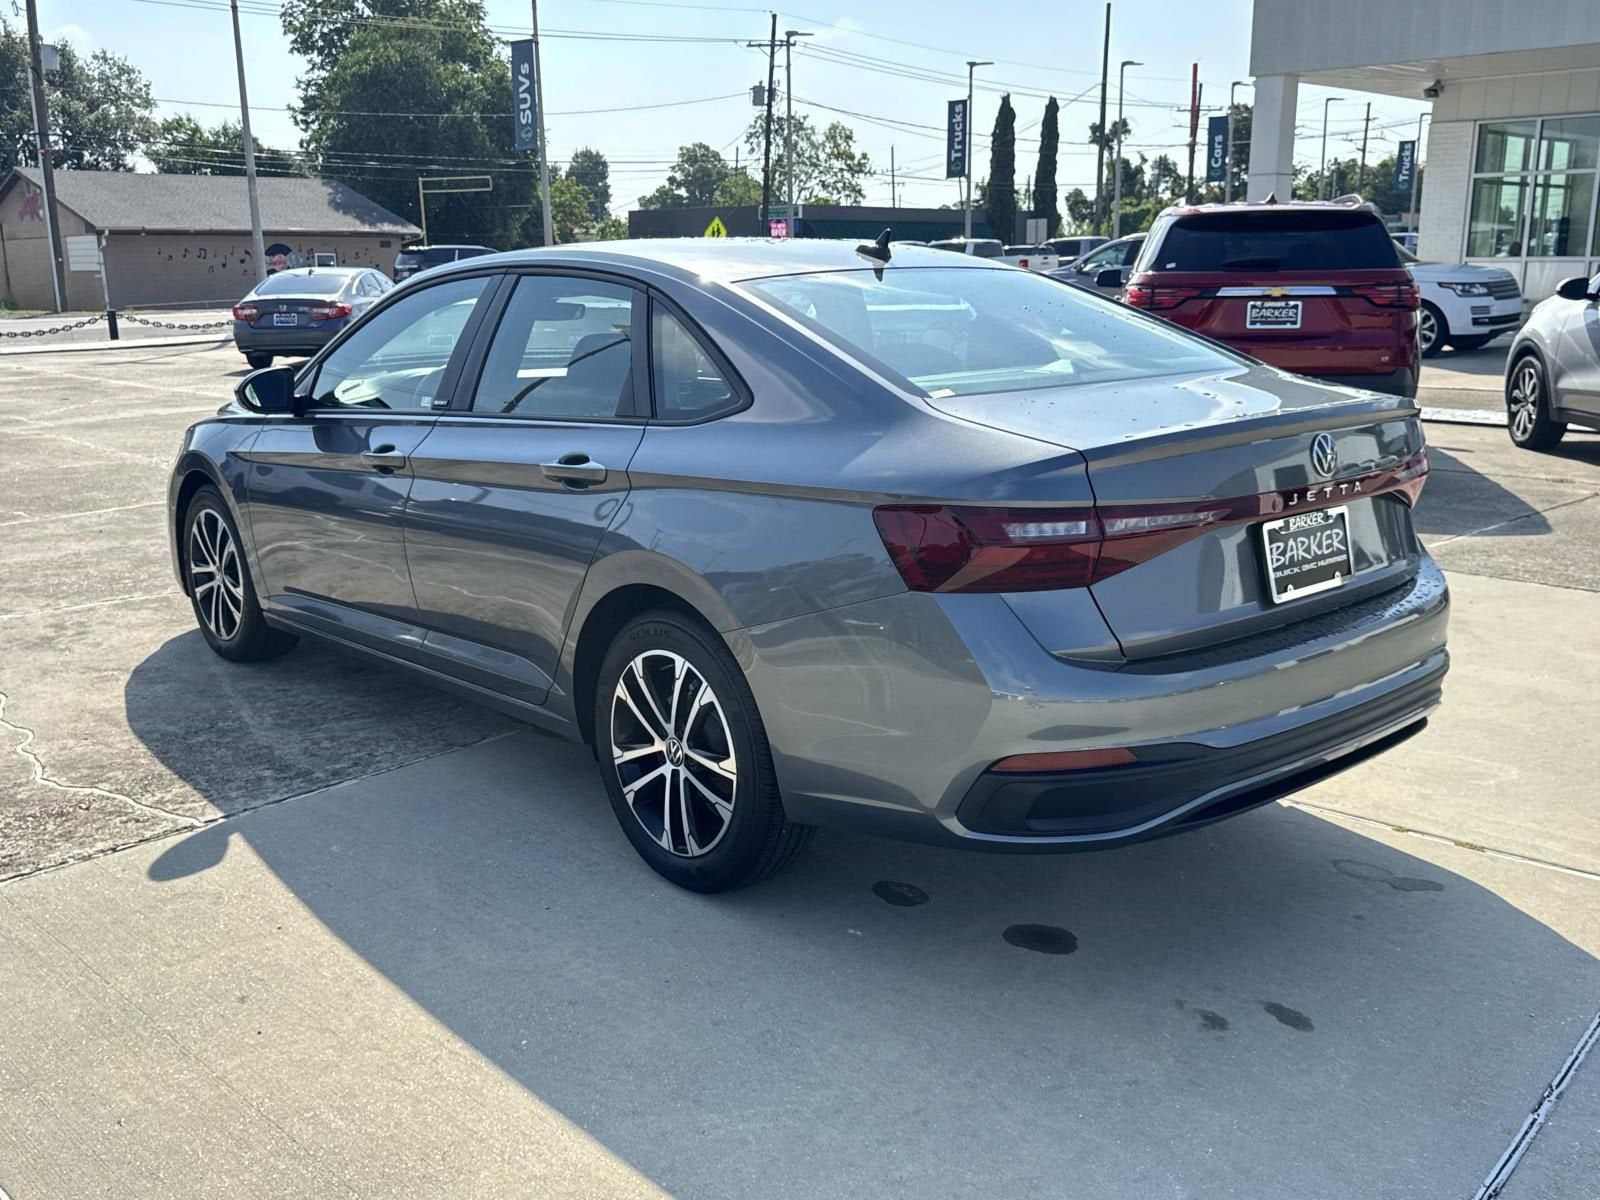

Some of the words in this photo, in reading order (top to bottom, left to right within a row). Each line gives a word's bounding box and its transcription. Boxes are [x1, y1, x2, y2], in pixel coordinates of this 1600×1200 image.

[518, 62, 532, 125] SUVs
[951, 103, 964, 162] Trucks
[1211, 134, 1223, 168] Cars
[1398, 143, 1412, 182] Trucks
[1251, 308, 1297, 318] BARKER
[1288, 480, 1362, 506] JETTA
[1289, 512, 1325, 532] BARKER
[1270, 528, 1347, 569] BARKER
[1274, 566, 1301, 579] BUICK
